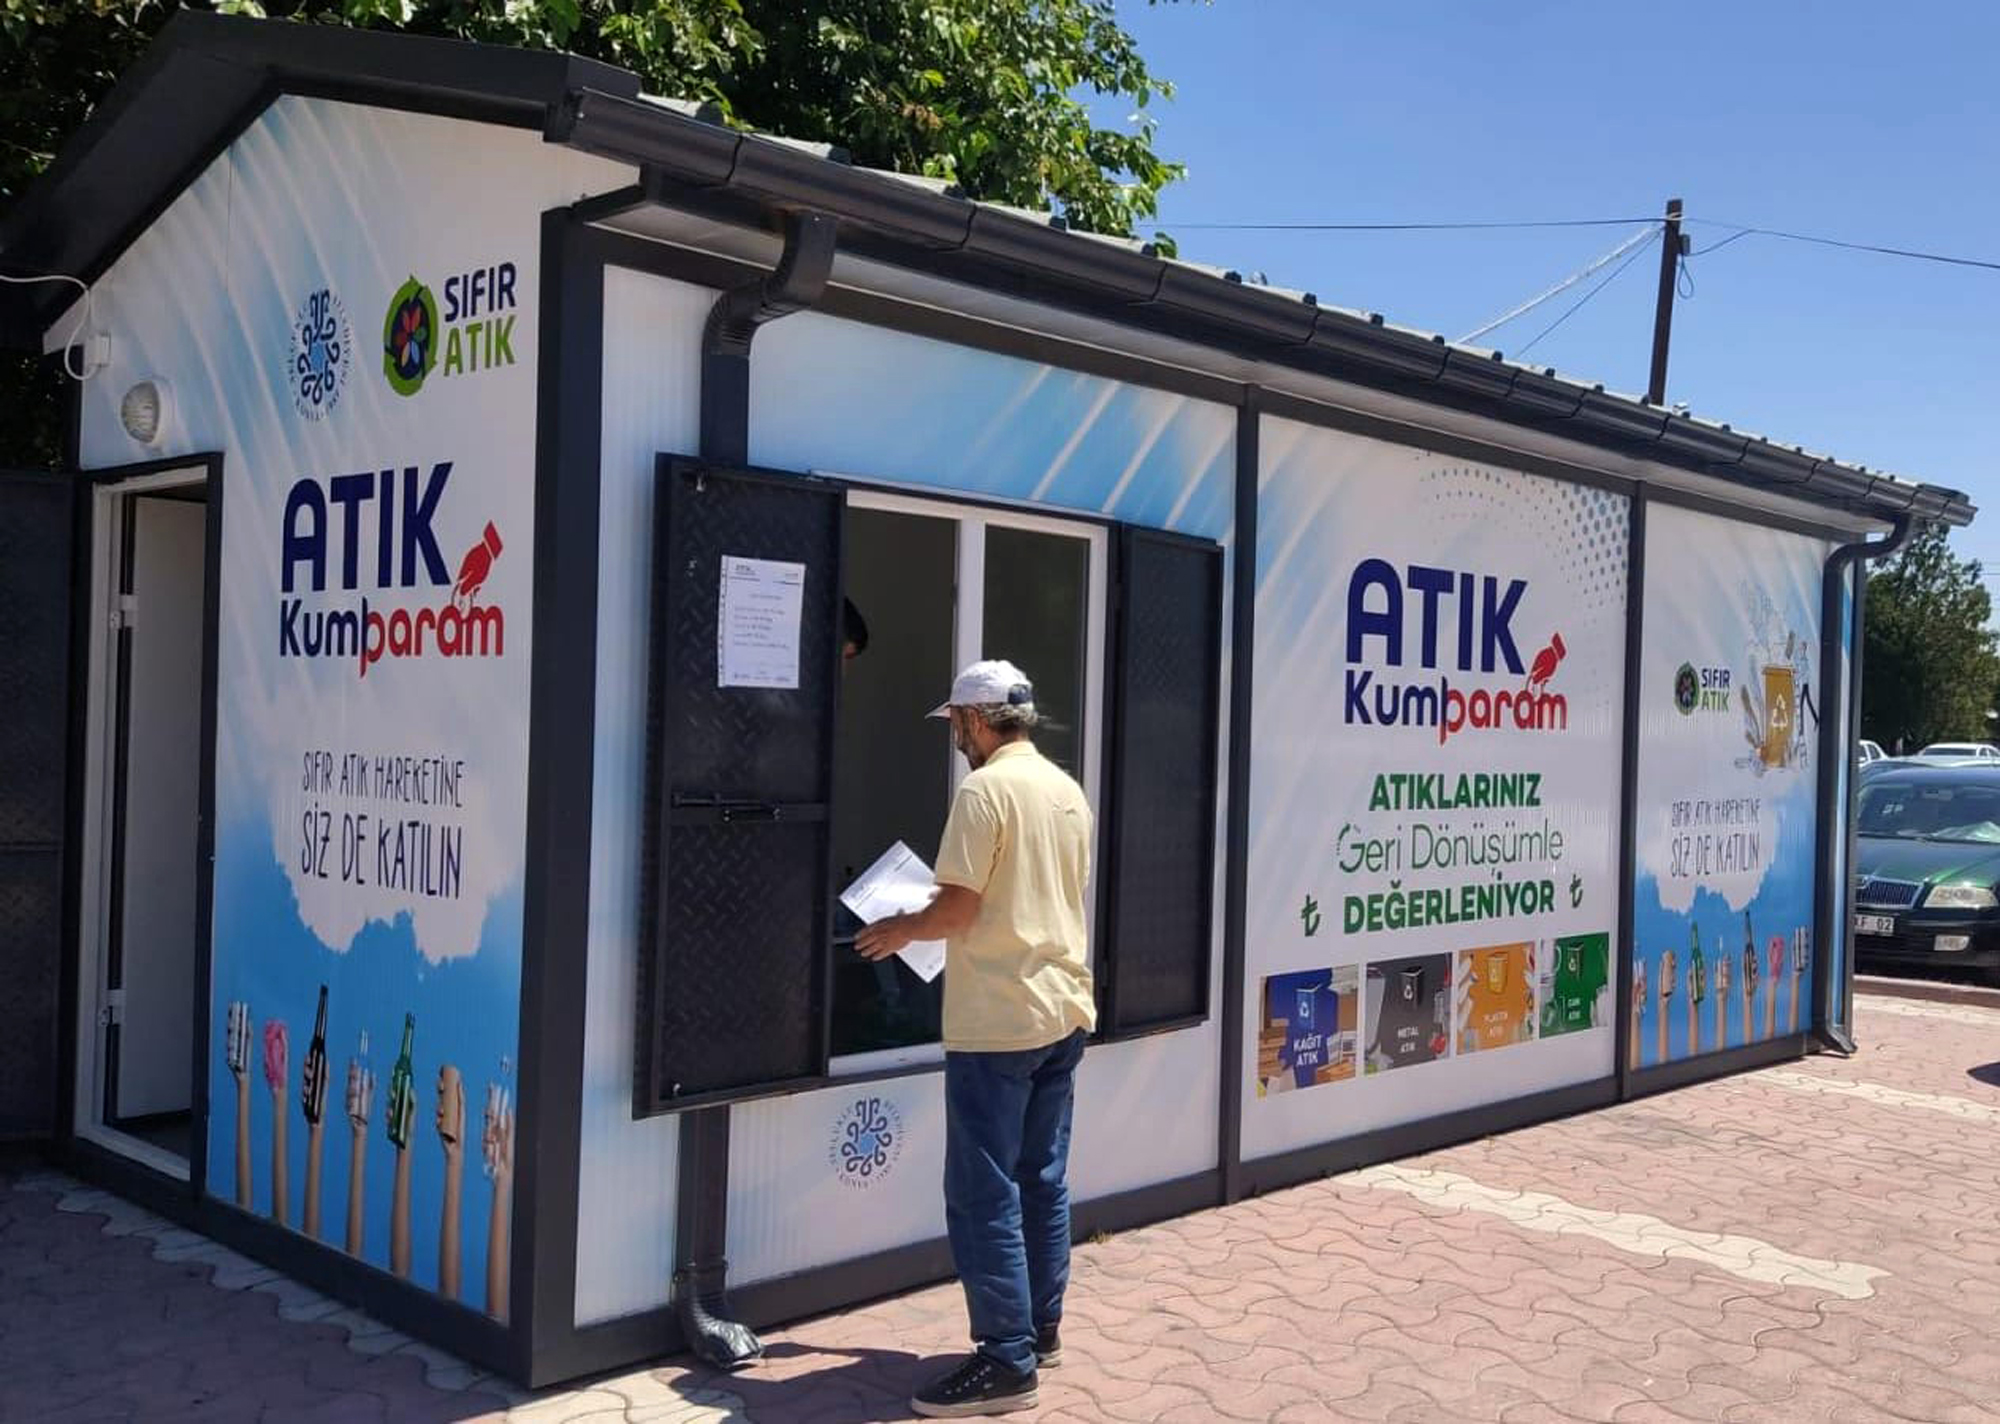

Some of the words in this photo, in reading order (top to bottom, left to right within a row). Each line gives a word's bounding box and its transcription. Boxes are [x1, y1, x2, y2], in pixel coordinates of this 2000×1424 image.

[444, 262, 516, 322] SIFIR
[443, 315, 516, 377] ATIK
[281, 462, 454, 593] ATIK
[1346, 558, 1528, 675] ATIK
[1701, 668, 1730, 690] SIFIR
[1701, 690, 1730, 712] ATIK
[303, 751, 334, 796] SIFIR
[340, 753, 368, 798] ATIK
[374, 755, 465, 808] HAREKETİNE
[1368, 773, 1542, 812] ATIKLARINIZ
[302, 802, 332, 879] SİZ
[342, 813, 367, 885] DE
[377, 818, 462, 900] KATILIN
[1336, 822, 1402, 874] Geri
[1411, 818, 1564, 877] Dönüşümle
[1671, 831, 1691, 877] SİZ
[1696, 835, 1711, 876] DE
[1716, 831, 1760, 875] KATILIN
[1343, 872, 1555, 934] DEĞERLENİYOR
[1296, 1051, 1319, 1066] ATIK
